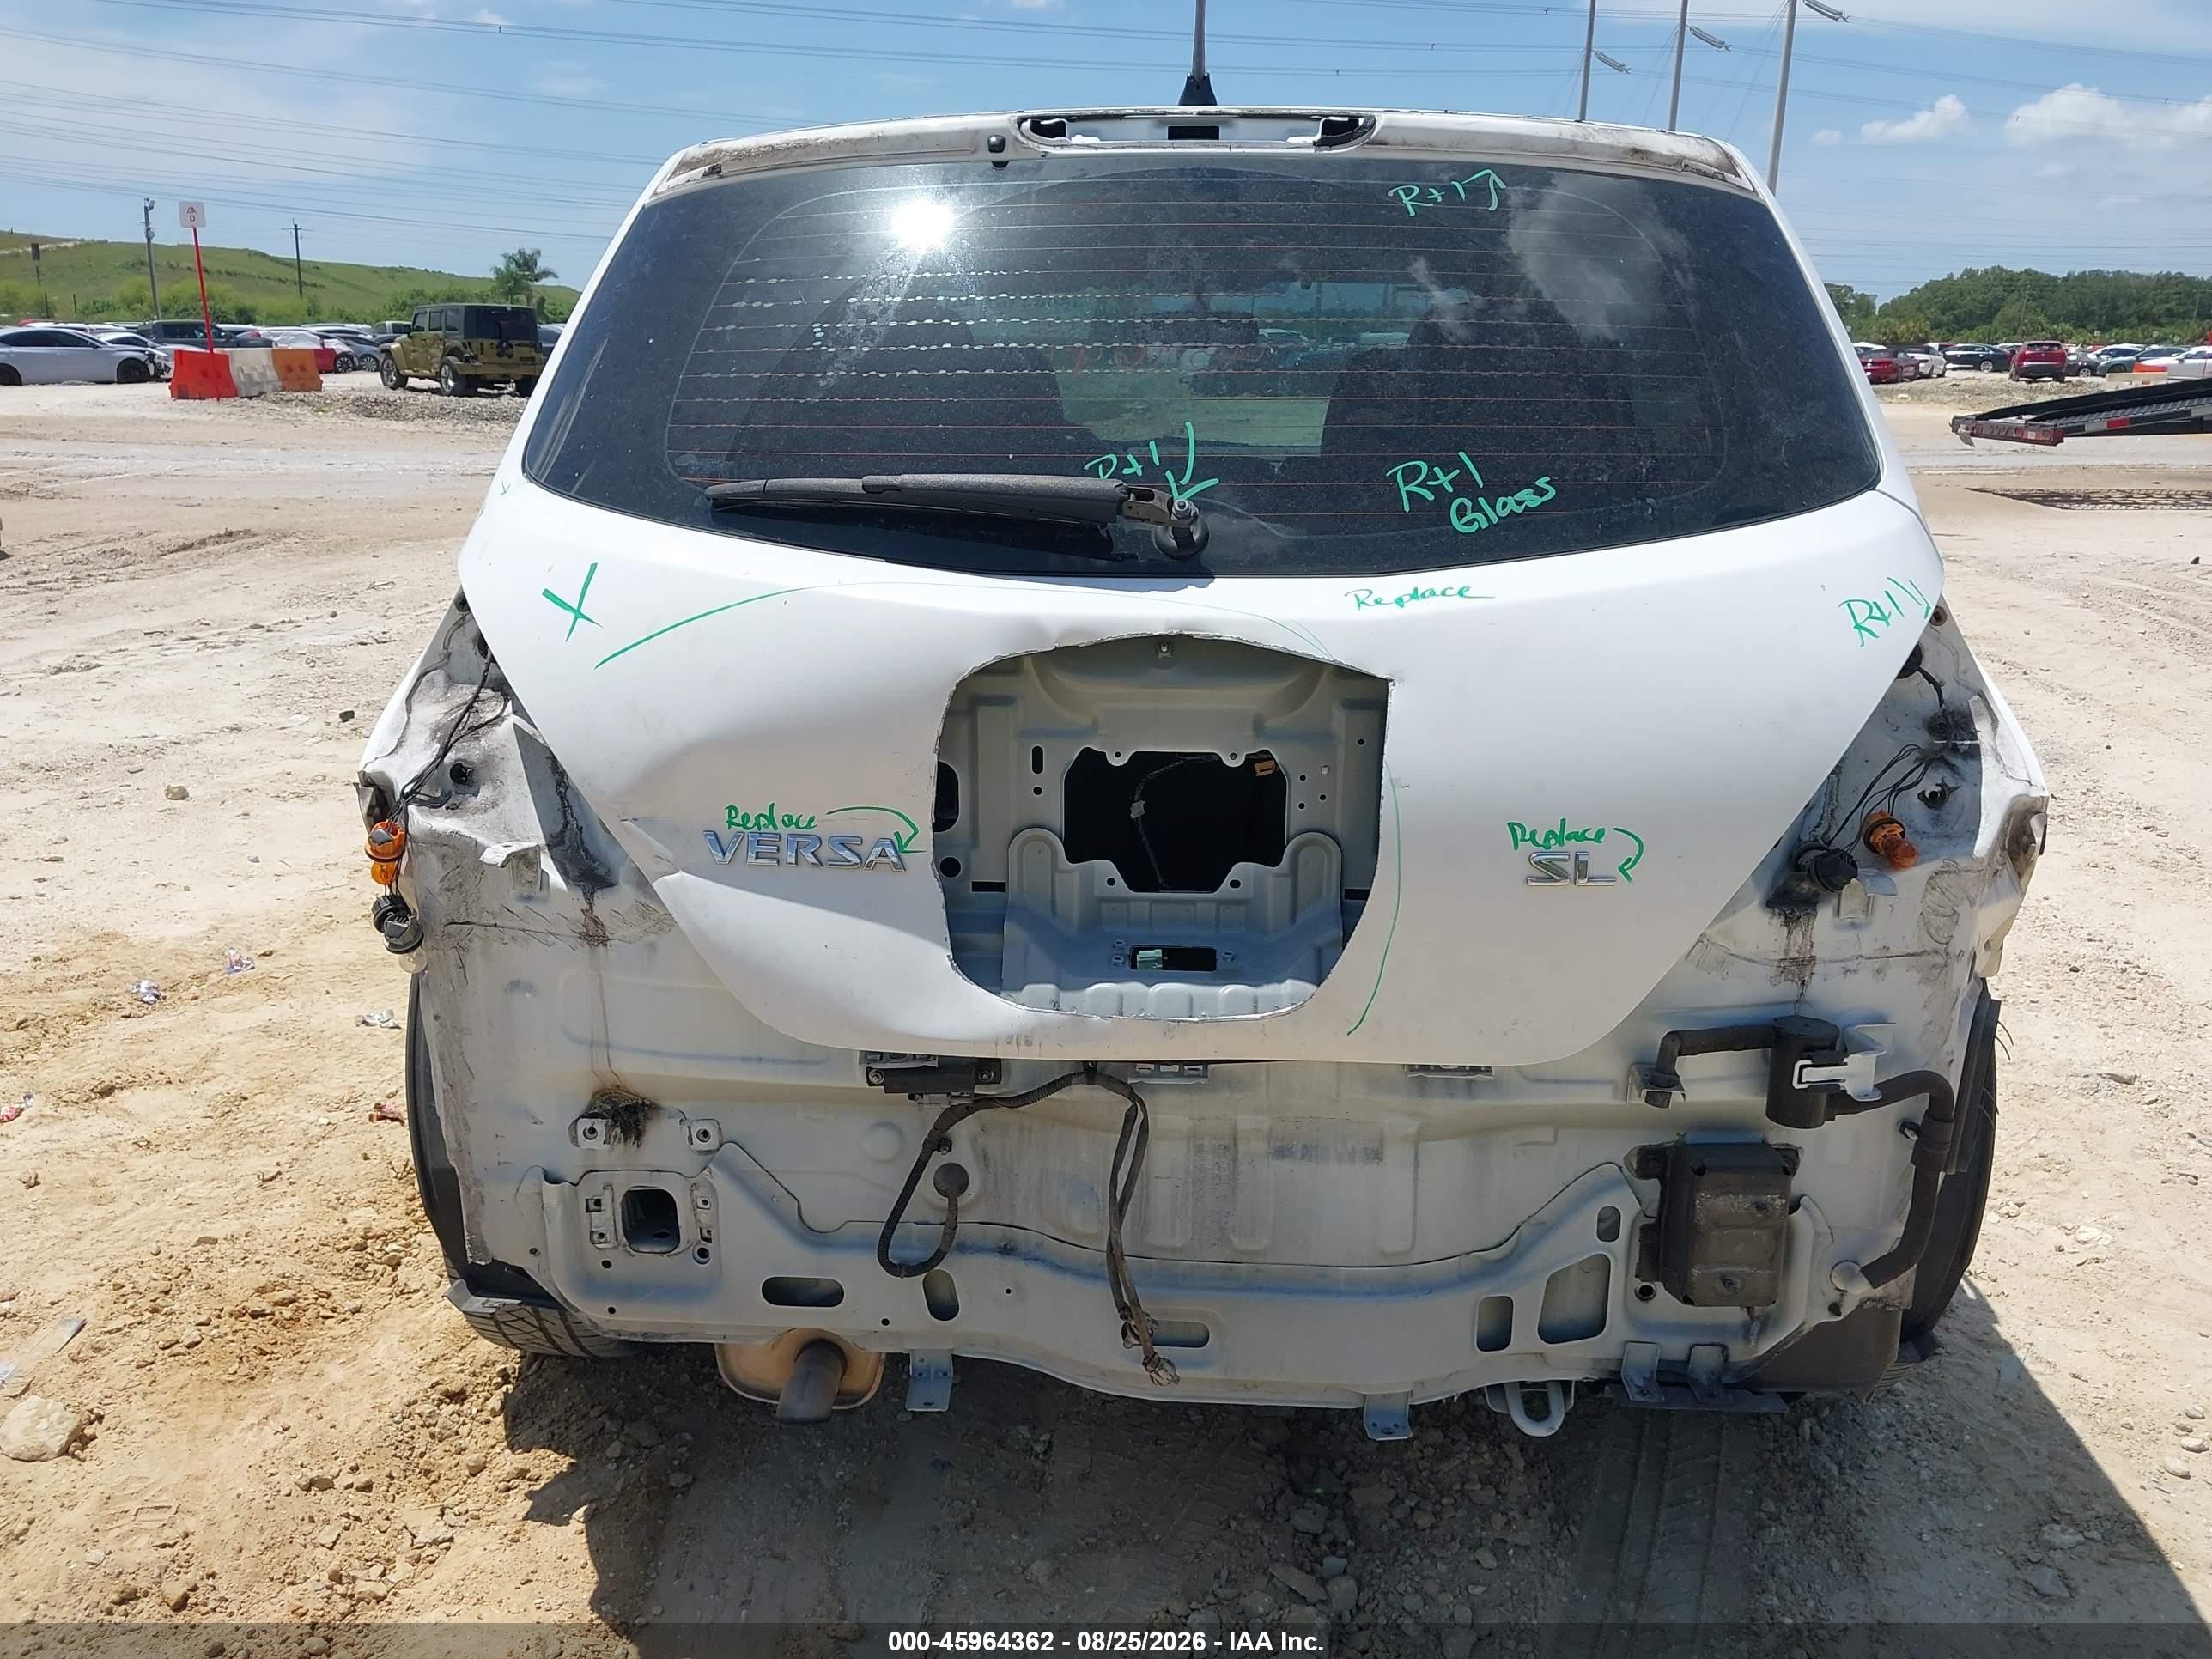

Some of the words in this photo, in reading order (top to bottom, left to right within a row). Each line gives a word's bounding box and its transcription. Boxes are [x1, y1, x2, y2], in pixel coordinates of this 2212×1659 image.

[1449, 476, 1557, 533] Glass
[1343, 585, 1496, 611] Replace
[702, 830, 907, 872] VERSA
[1506, 817, 1607, 851] Replace
[1525, 851, 1617, 887] SL
